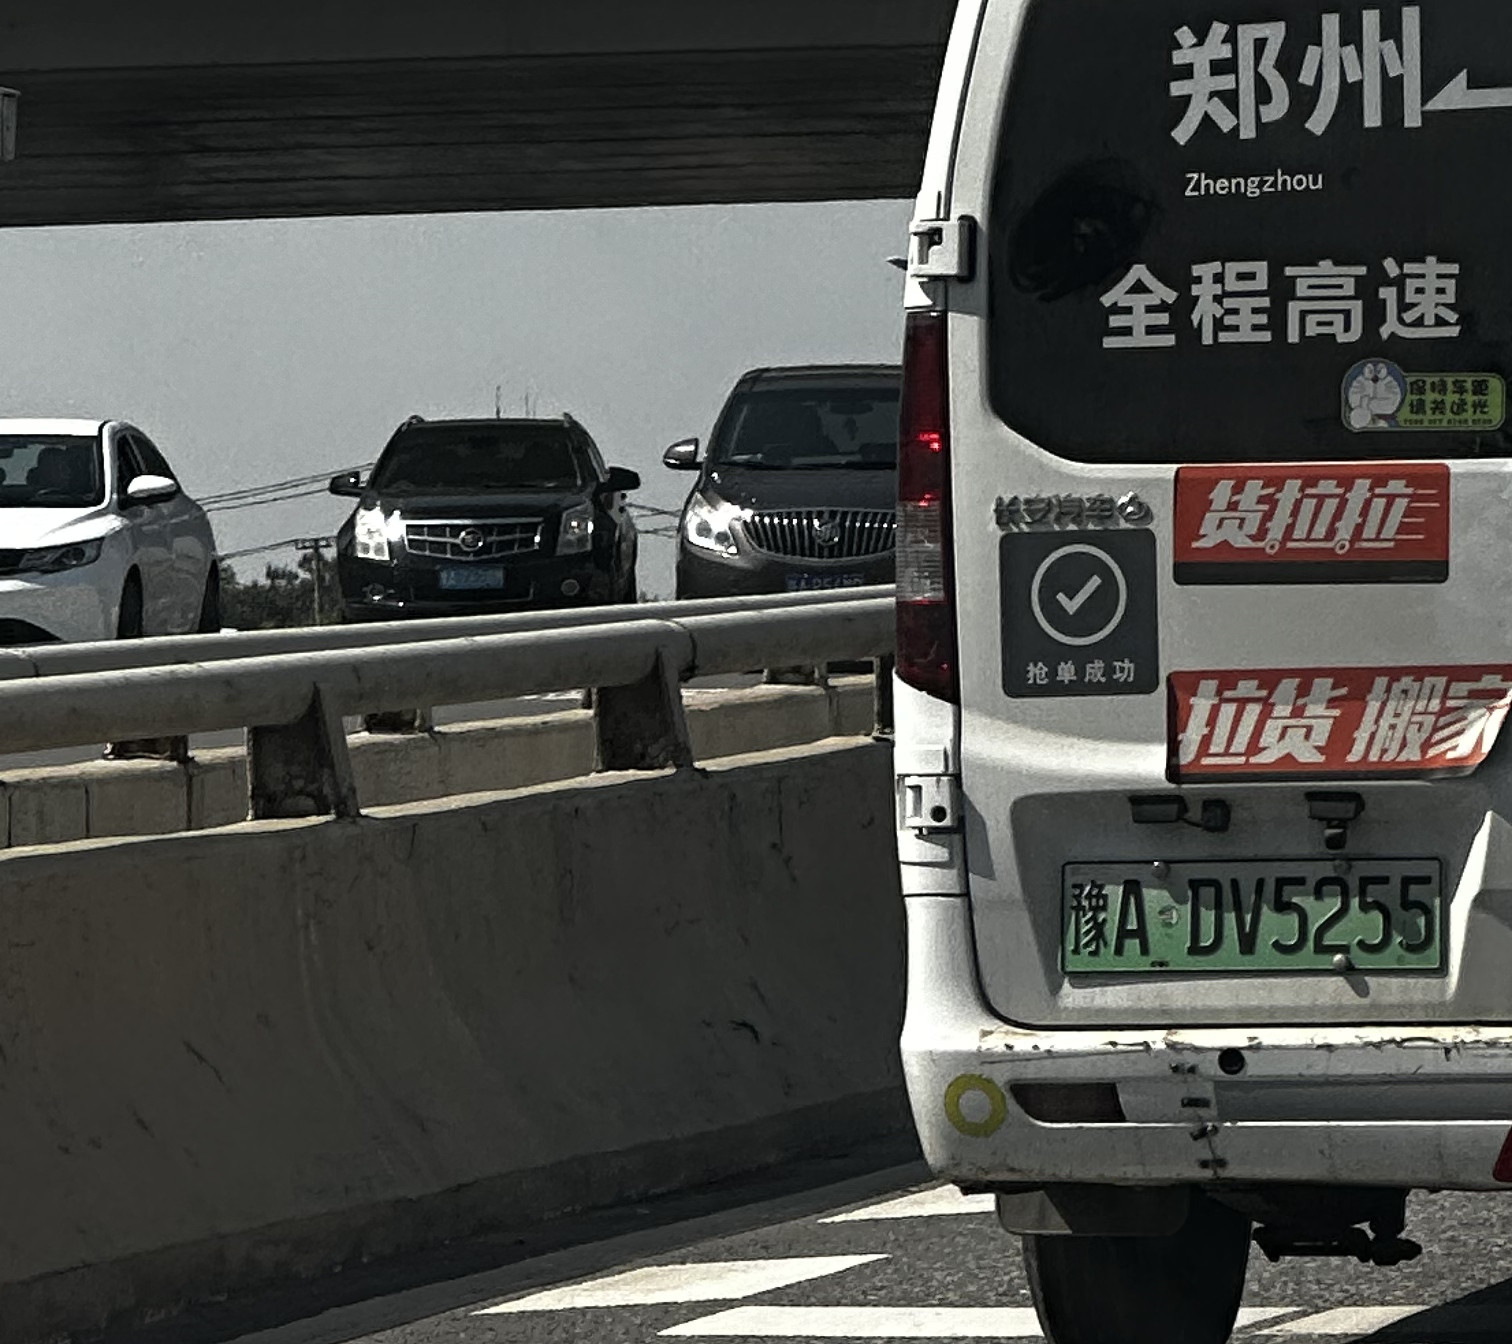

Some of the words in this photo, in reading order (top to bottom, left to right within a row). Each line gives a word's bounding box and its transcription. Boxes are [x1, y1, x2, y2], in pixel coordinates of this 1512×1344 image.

[1168, 4, 1422, 146] 郑州
[1184, 168, 1324, 198] Zhengzhou
[1099, 256, 1462, 348] 全程高速
[1191, 478, 1425, 555] 货拉拉
[1026, 658, 1136, 685] 抢单成功
[1178, 677, 1349, 766] 拉货
[1070, 878, 1150, 957] 豫A
[1186, 875, 1434, 956] DV5255
